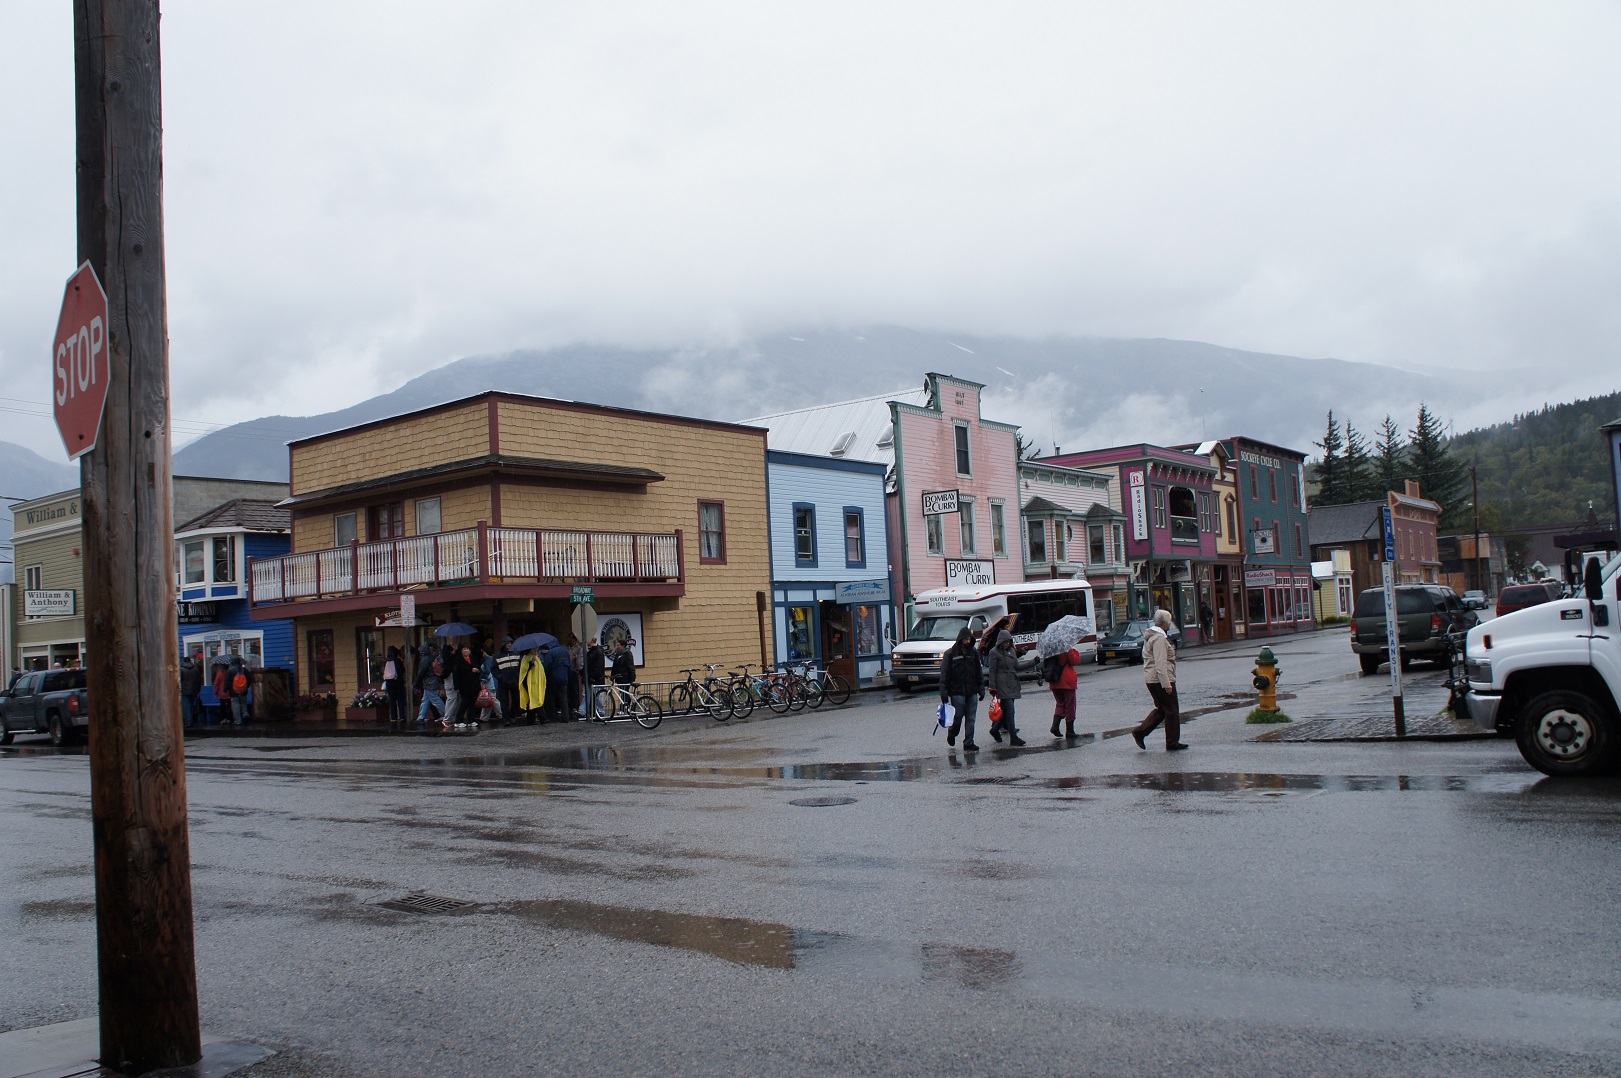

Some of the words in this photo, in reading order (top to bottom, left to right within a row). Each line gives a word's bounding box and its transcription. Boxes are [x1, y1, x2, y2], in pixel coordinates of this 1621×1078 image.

[56, 315, 103, 407] STOP
[1240, 451, 1260, 465] SOCKEYE
[1261, 455, 1273, 467] CYCLE
[924, 492, 956, 508] BOMBAY
[931, 501, 957, 512] CURRY
[26, 507, 66, 524] William
[70, 502, 78, 515] &
[949, 562, 981, 578] BOMBAY
[965, 573, 991, 585] CURRY
[64, 591, 70, 599] &
[573, 586, 591, 594] BROADWAY
[1384, 575, 1392, 610] CITY
[1389, 620, 1398, 683] TRANSIT
